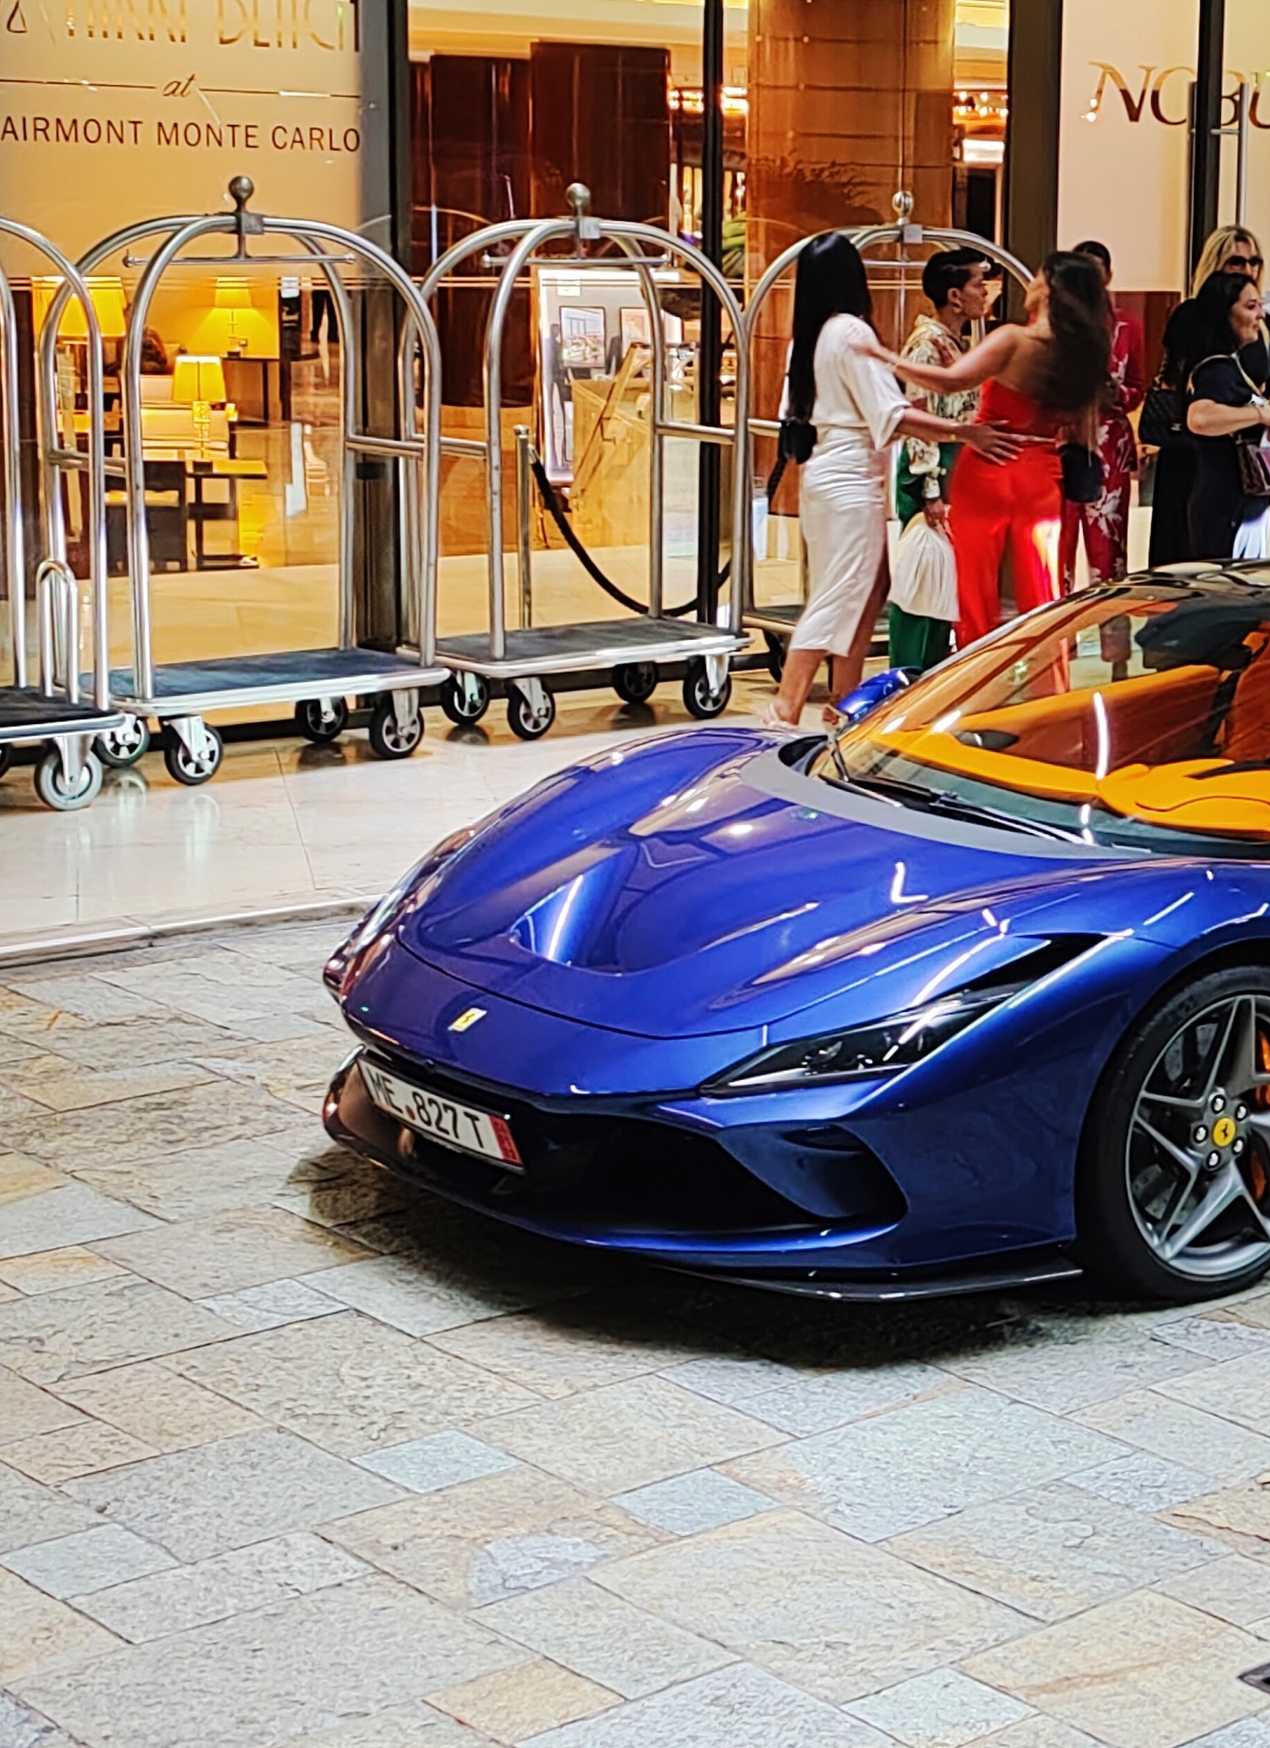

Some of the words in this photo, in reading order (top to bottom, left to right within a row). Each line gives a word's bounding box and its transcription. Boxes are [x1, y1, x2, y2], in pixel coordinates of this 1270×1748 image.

[162, 73, 196, 98] at
[157, 121, 260, 149] MONTE
[271, 125, 362, 152] CARLO
